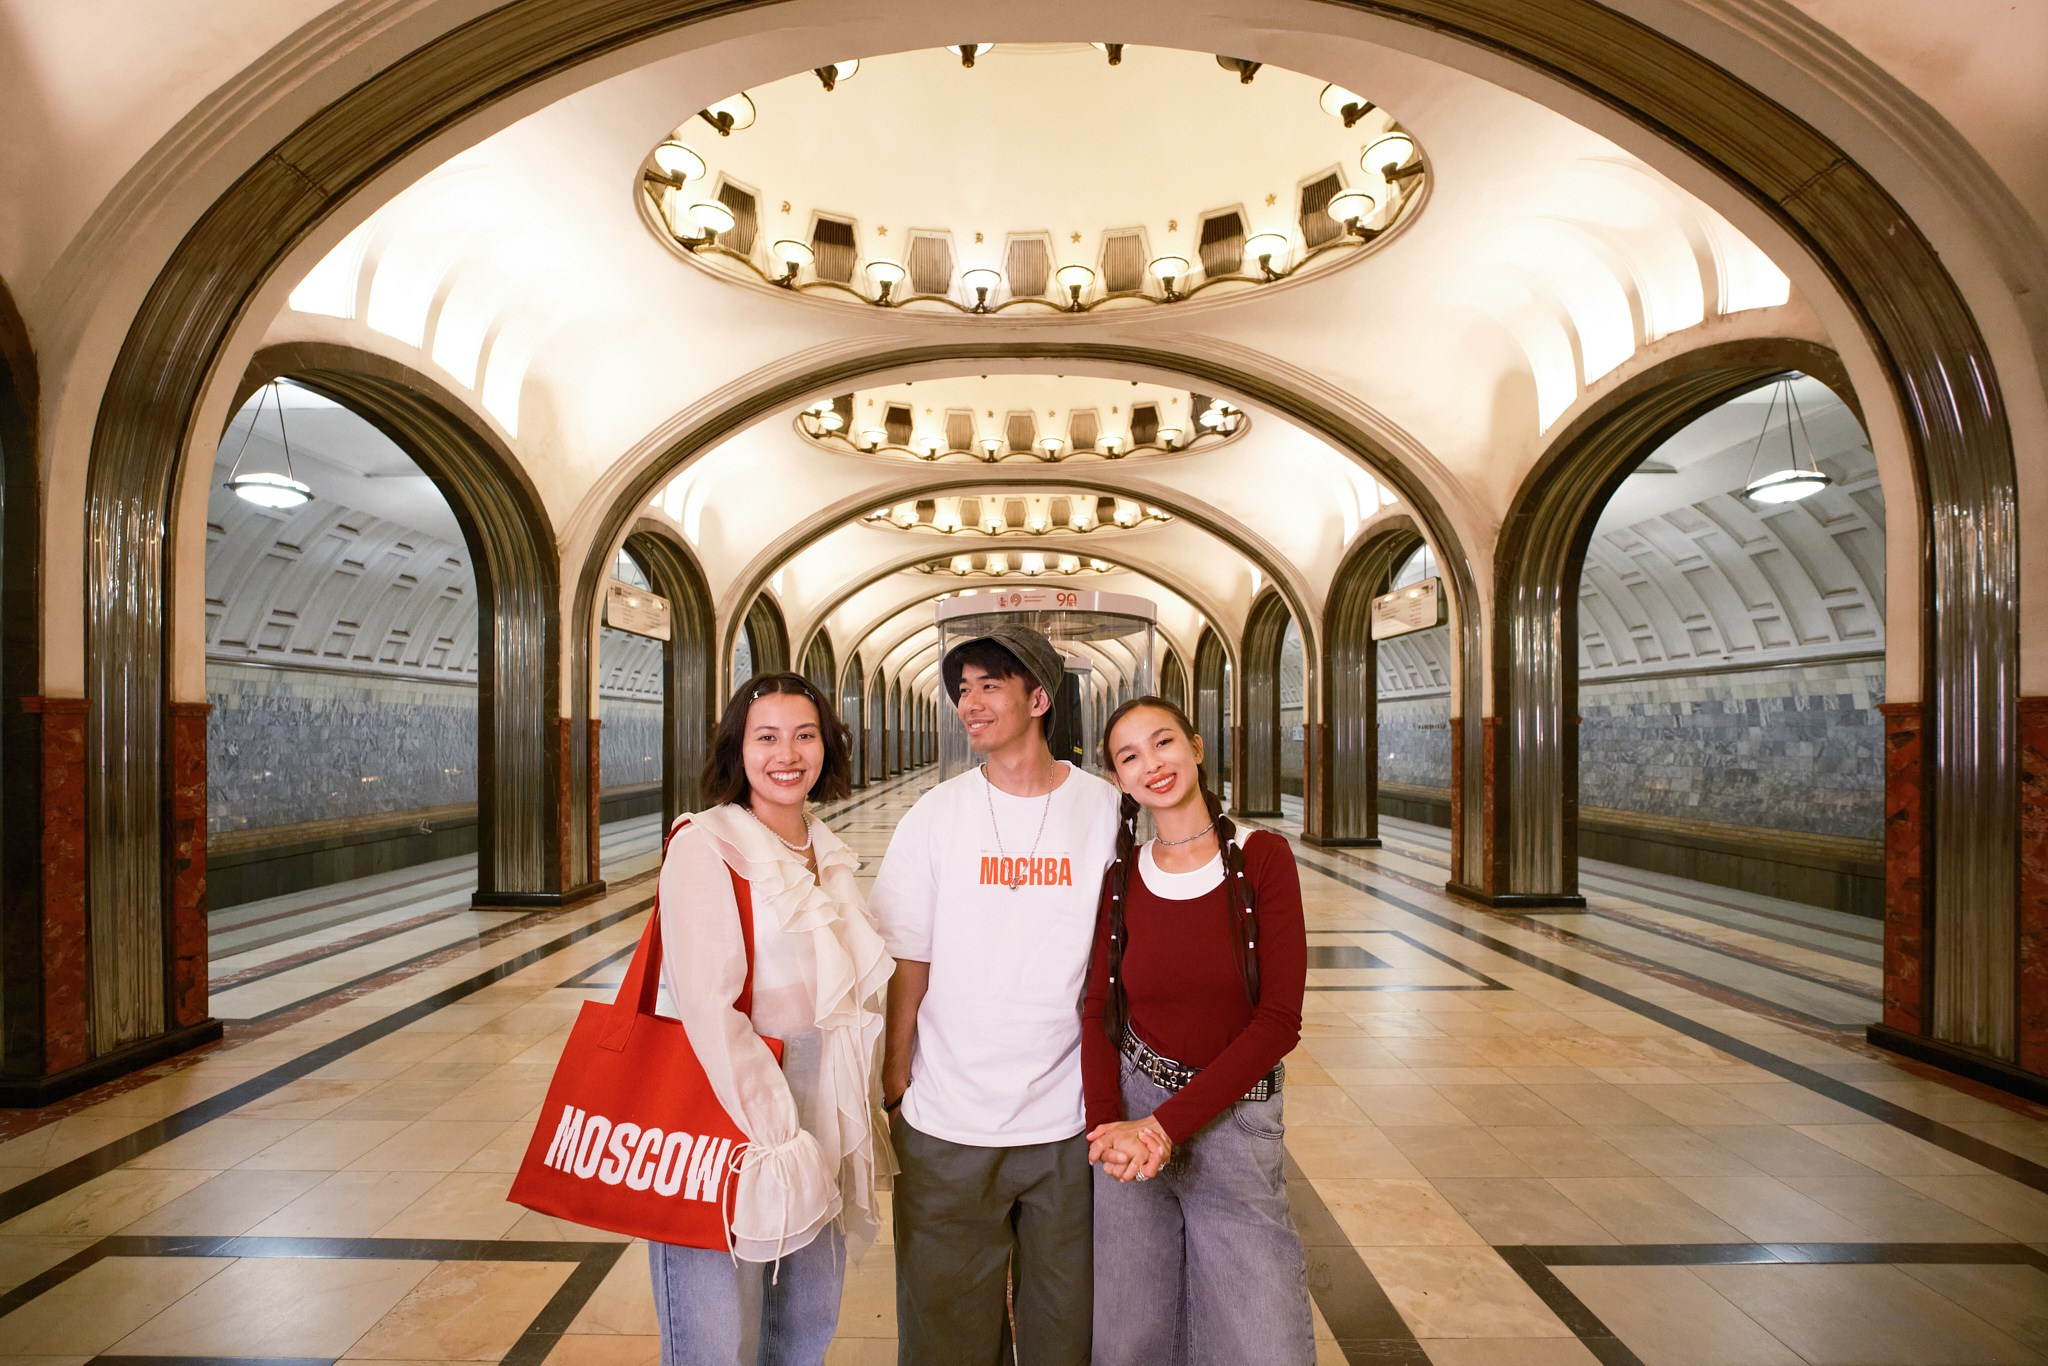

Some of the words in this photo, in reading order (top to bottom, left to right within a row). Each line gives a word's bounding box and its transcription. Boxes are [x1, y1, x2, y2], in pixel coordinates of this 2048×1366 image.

[1056, 592, 1077, 607] 90
[980, 857, 1072, 886] МОСКВА
[544, 1104, 732, 1203] MOSCOW
